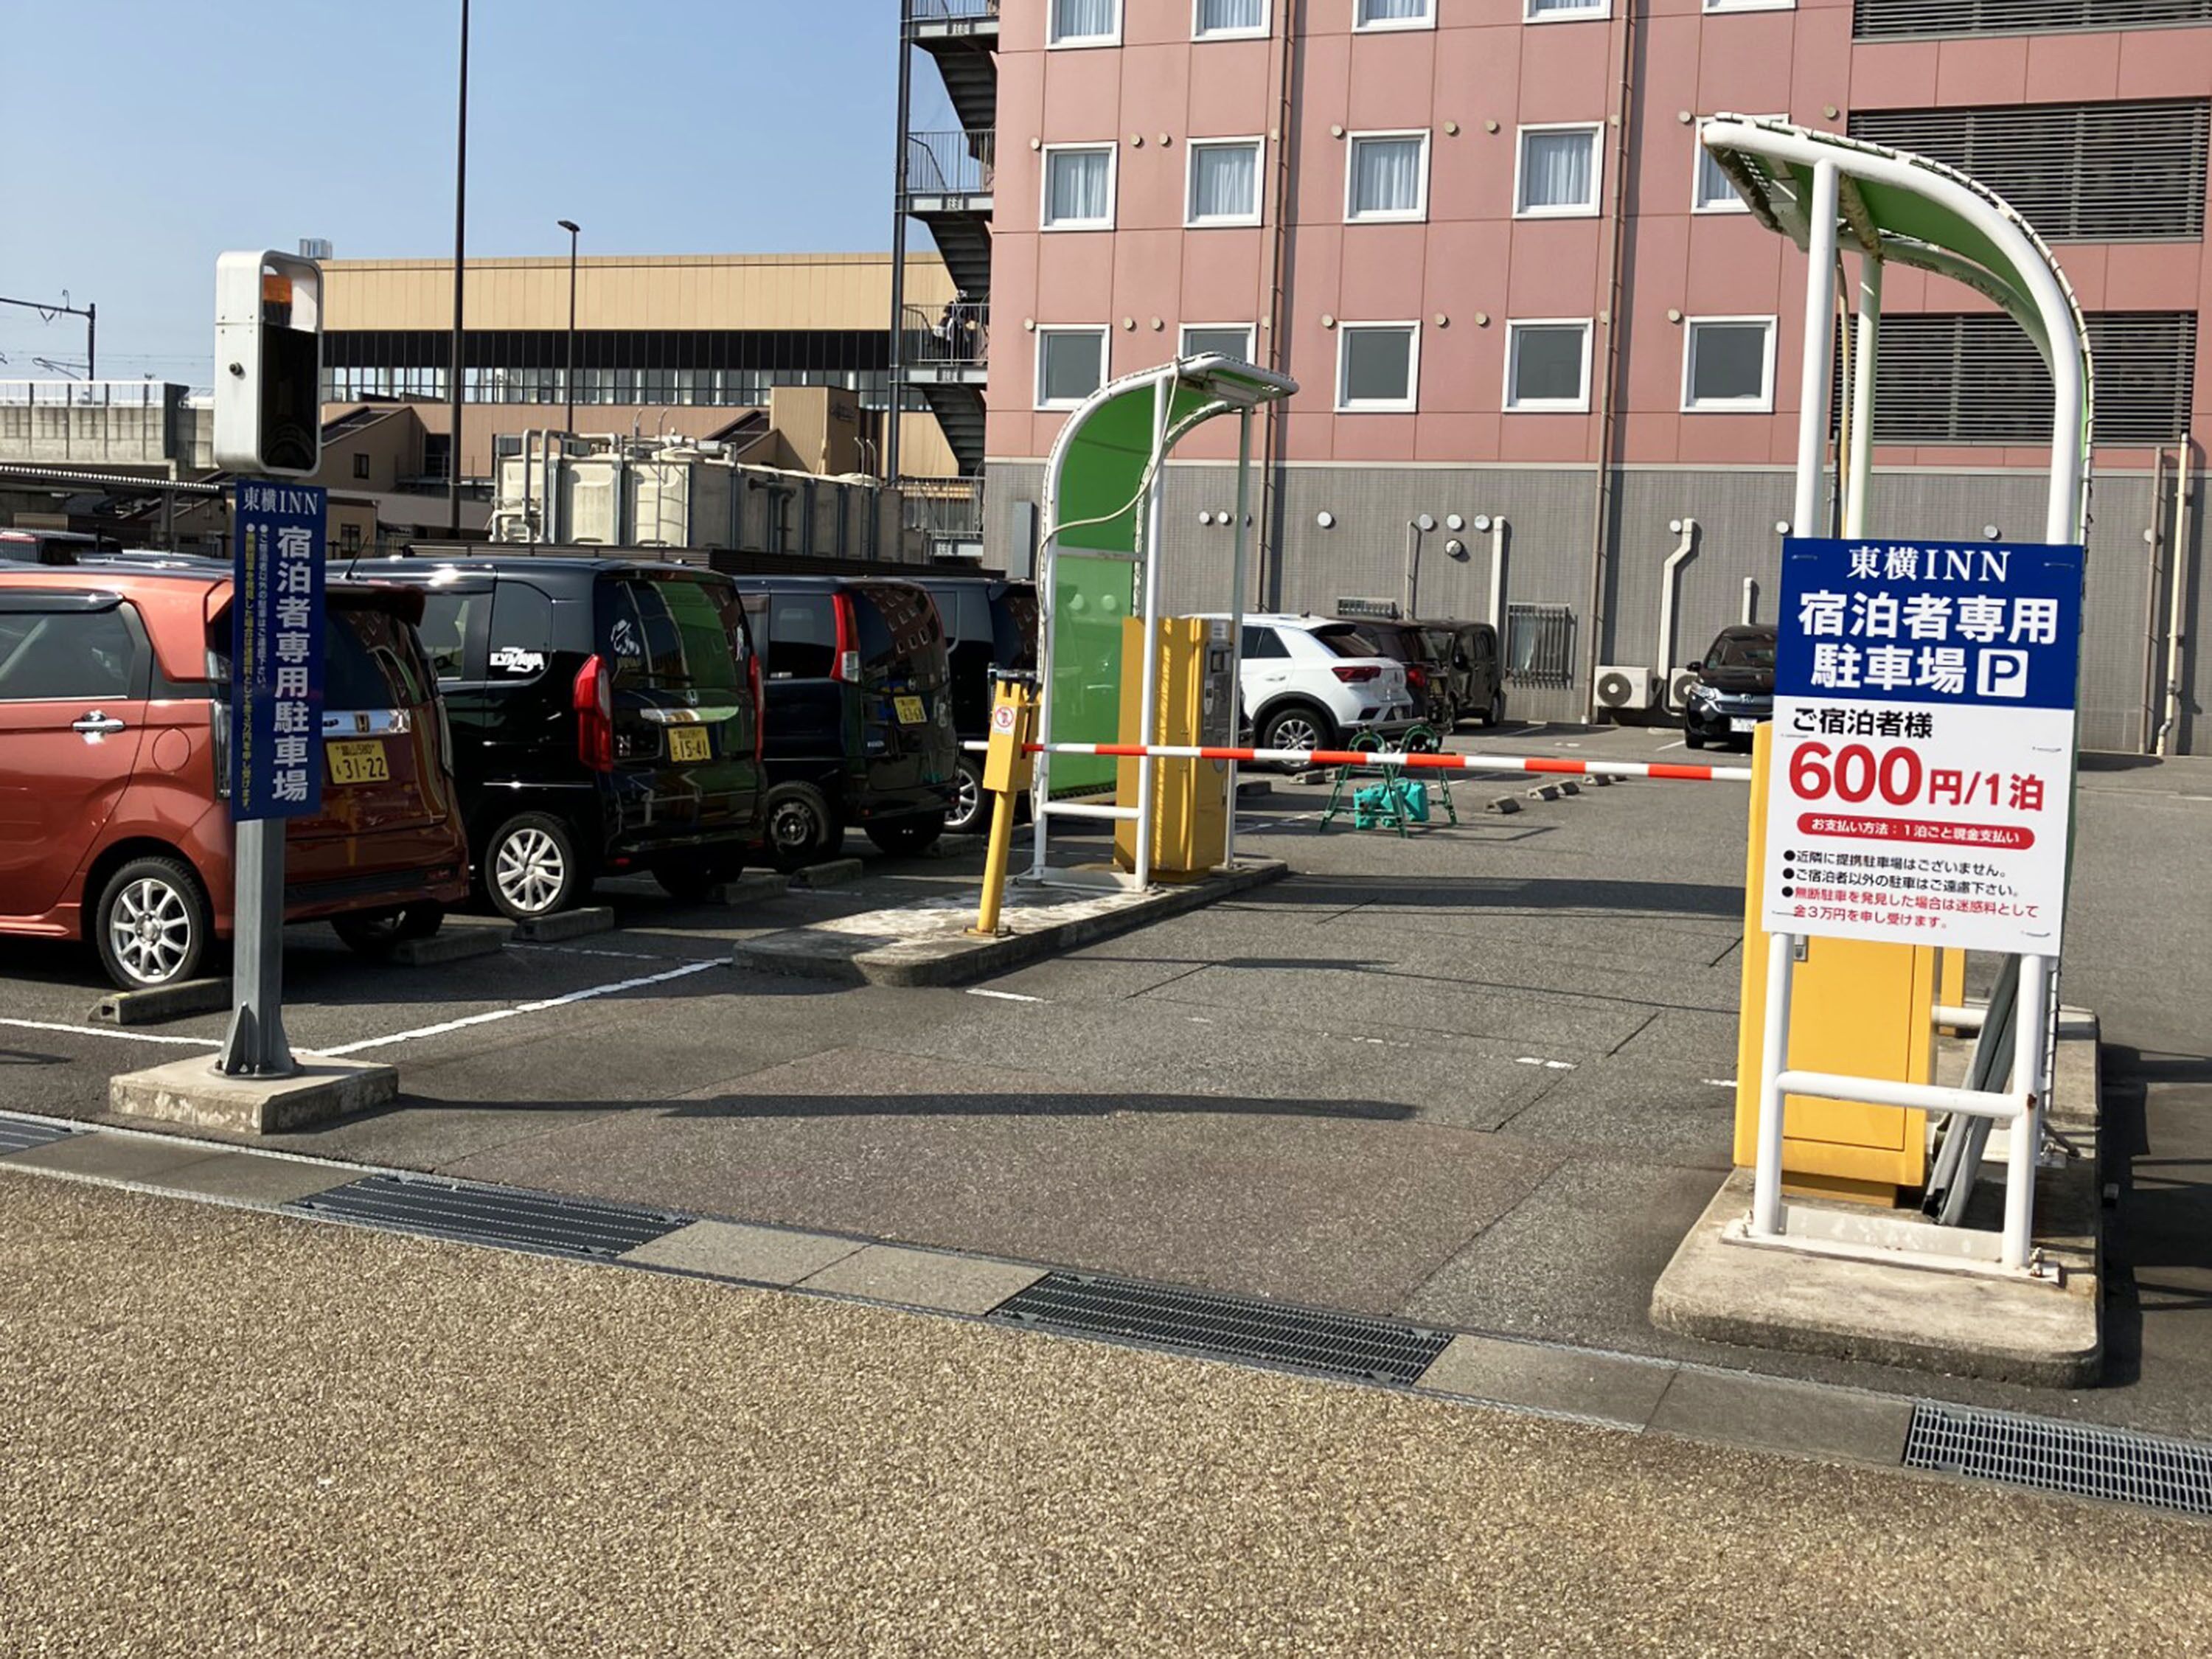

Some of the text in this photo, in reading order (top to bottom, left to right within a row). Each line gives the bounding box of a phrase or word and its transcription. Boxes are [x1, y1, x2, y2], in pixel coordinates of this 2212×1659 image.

[243, 486, 319, 515] 東横INN
[1846, 545, 2011, 583] 東横INN
[1798, 589, 2059, 645] 宿泊者専用
[271, 525, 313, 802] 宿泊者専用駐車場
[1810, 642, 1967, 695] 駐車場
[1792, 707, 1933, 739] ご宿泊者様
[342, 757, 387, 779] 31-22
[1796, 850, 2006, 878] 近隣に提携駐車場はございません。
[1795, 868, 2018, 897] ご宿泊者以外の駐車はご遠慮下さい。
